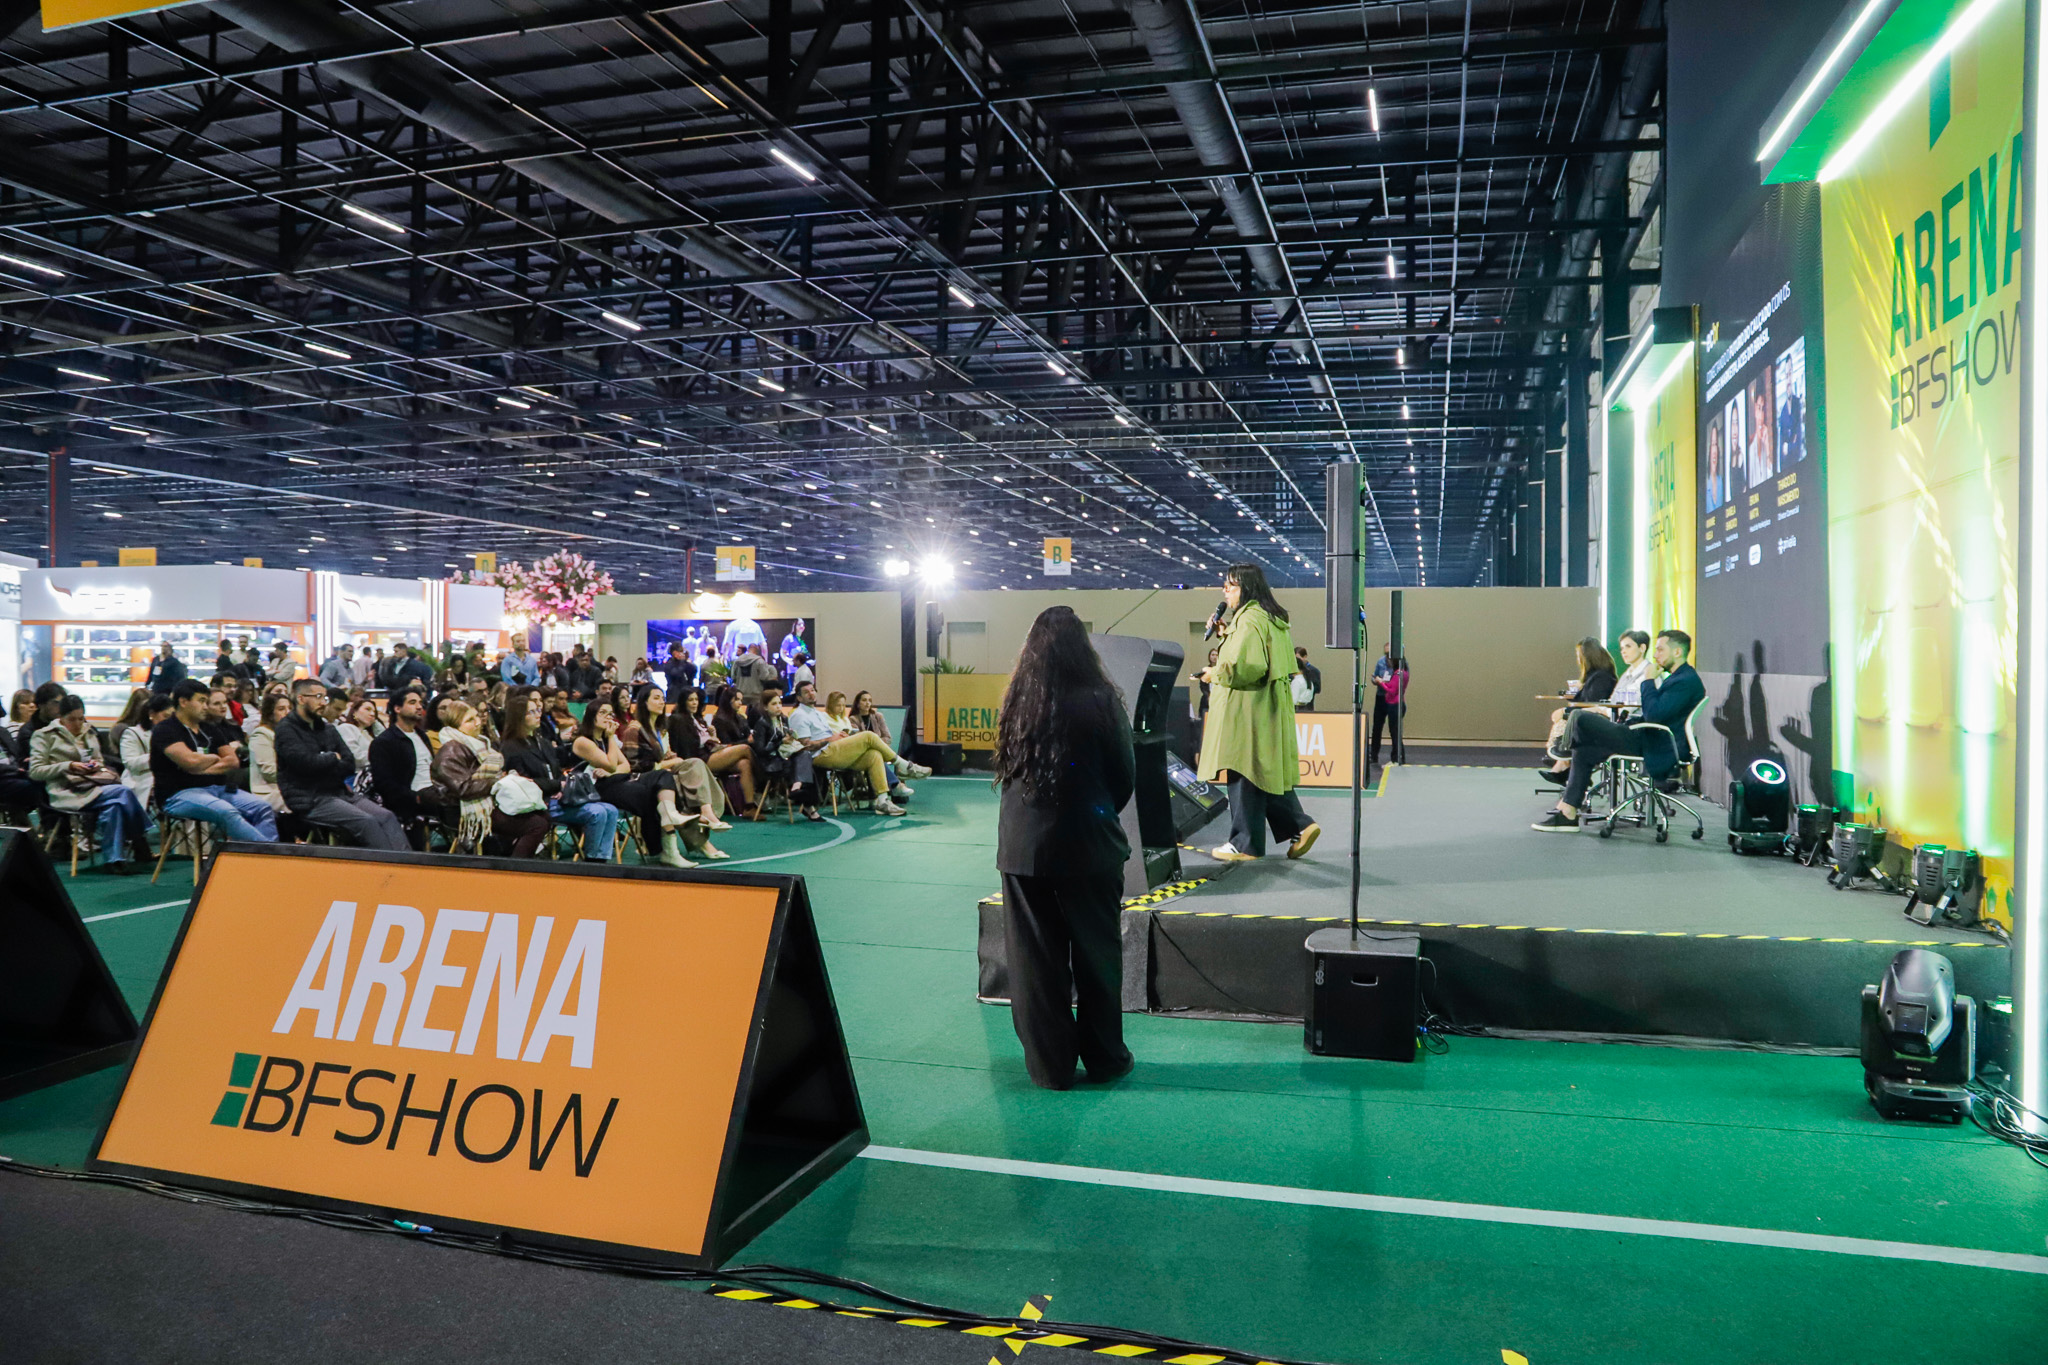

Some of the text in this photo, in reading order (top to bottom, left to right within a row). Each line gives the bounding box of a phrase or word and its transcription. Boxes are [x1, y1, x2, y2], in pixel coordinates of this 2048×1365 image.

[739, 554, 747, 572] C
[1052, 545, 1062, 564] B
[272, 900, 606, 1069] ARENA
[243, 1056, 619, 1178] BFSHOW
